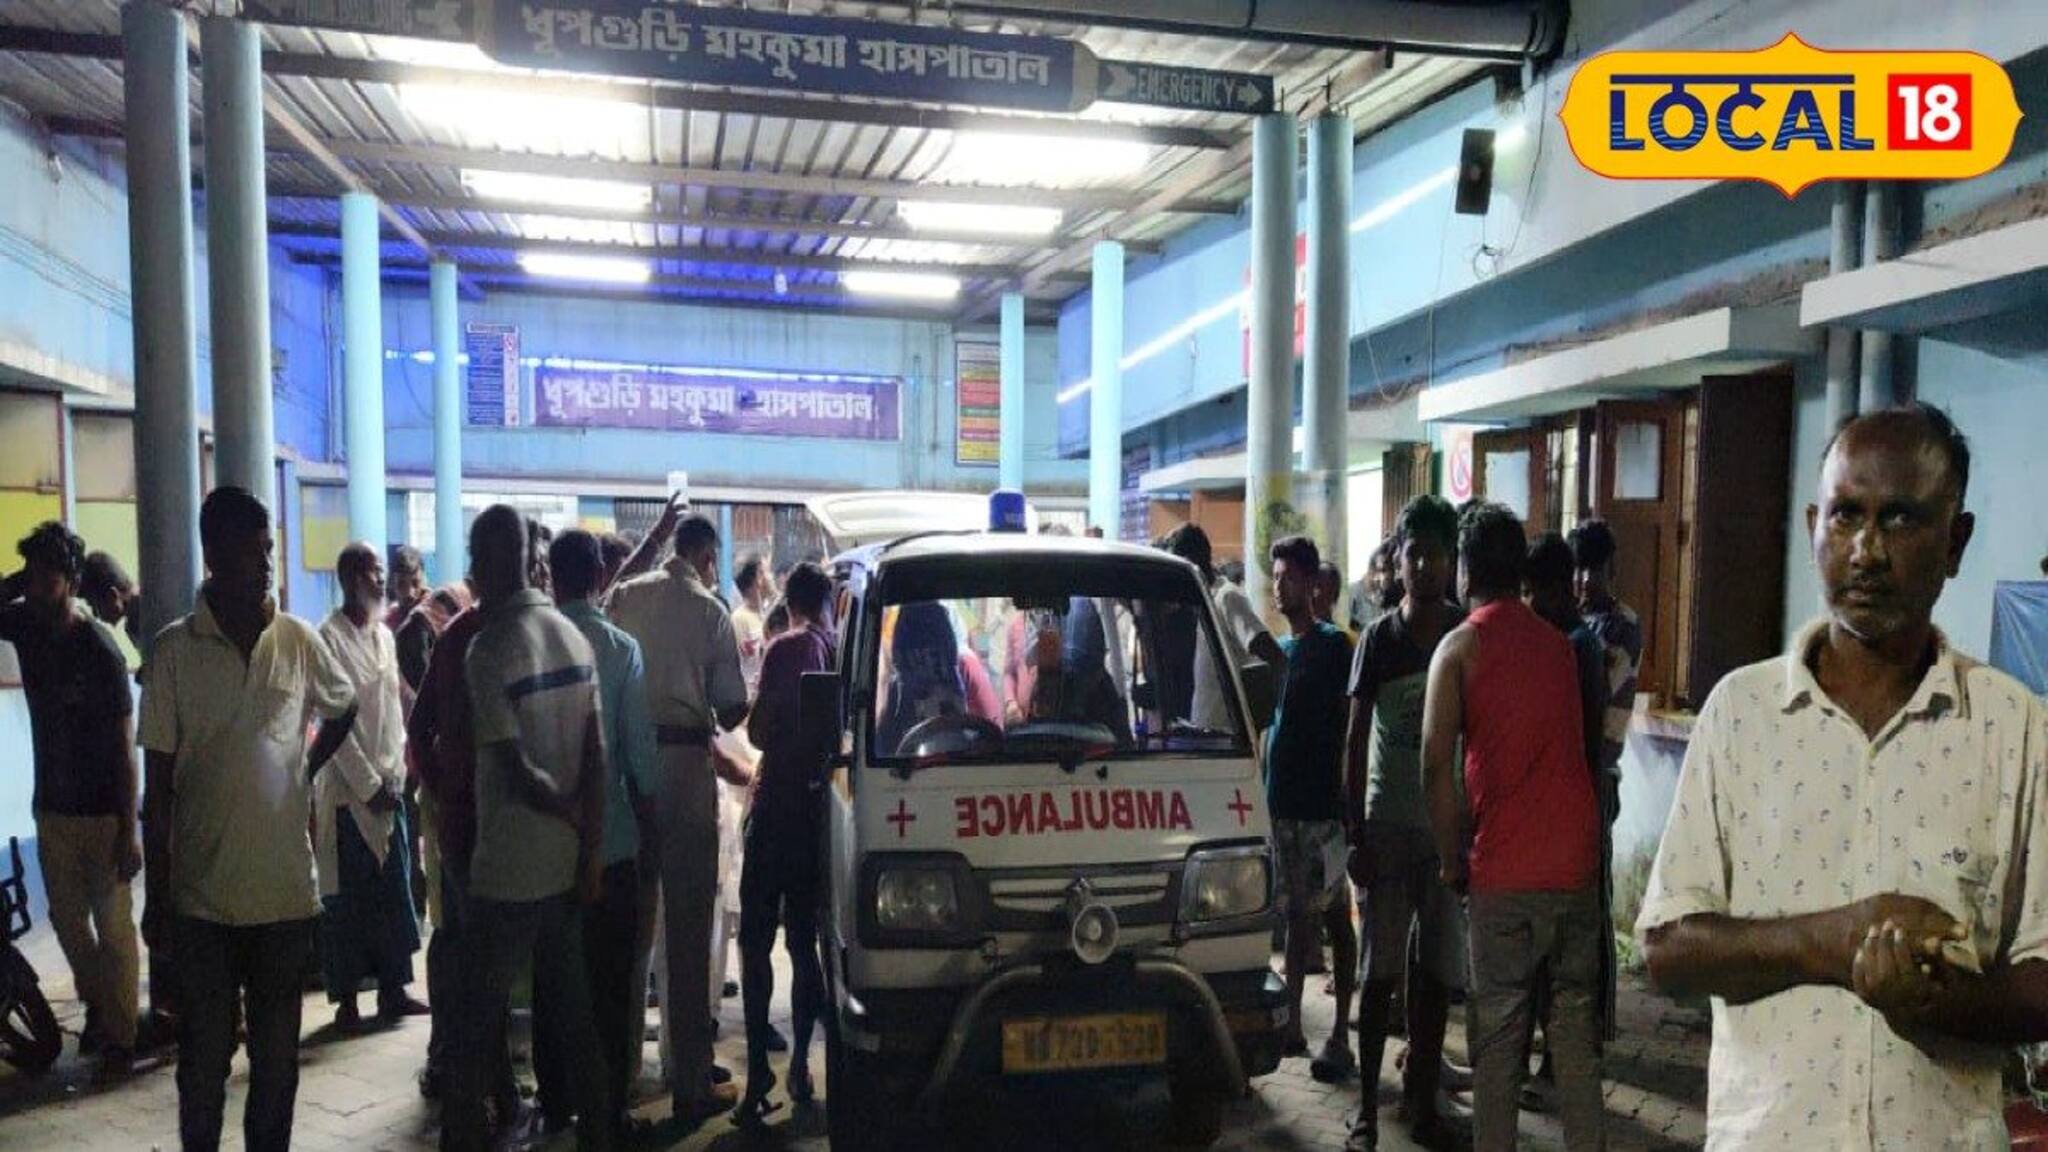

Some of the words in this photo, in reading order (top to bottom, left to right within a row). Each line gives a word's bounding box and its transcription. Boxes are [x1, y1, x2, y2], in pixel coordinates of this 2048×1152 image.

[701, 25, 848, 80] মহকুমা
[857, 39, 1050, 87] হাসপাতাল
[1136, 67, 1236, 107] EMERGENCY
[648, 384, 736, 427] মহকুমা
